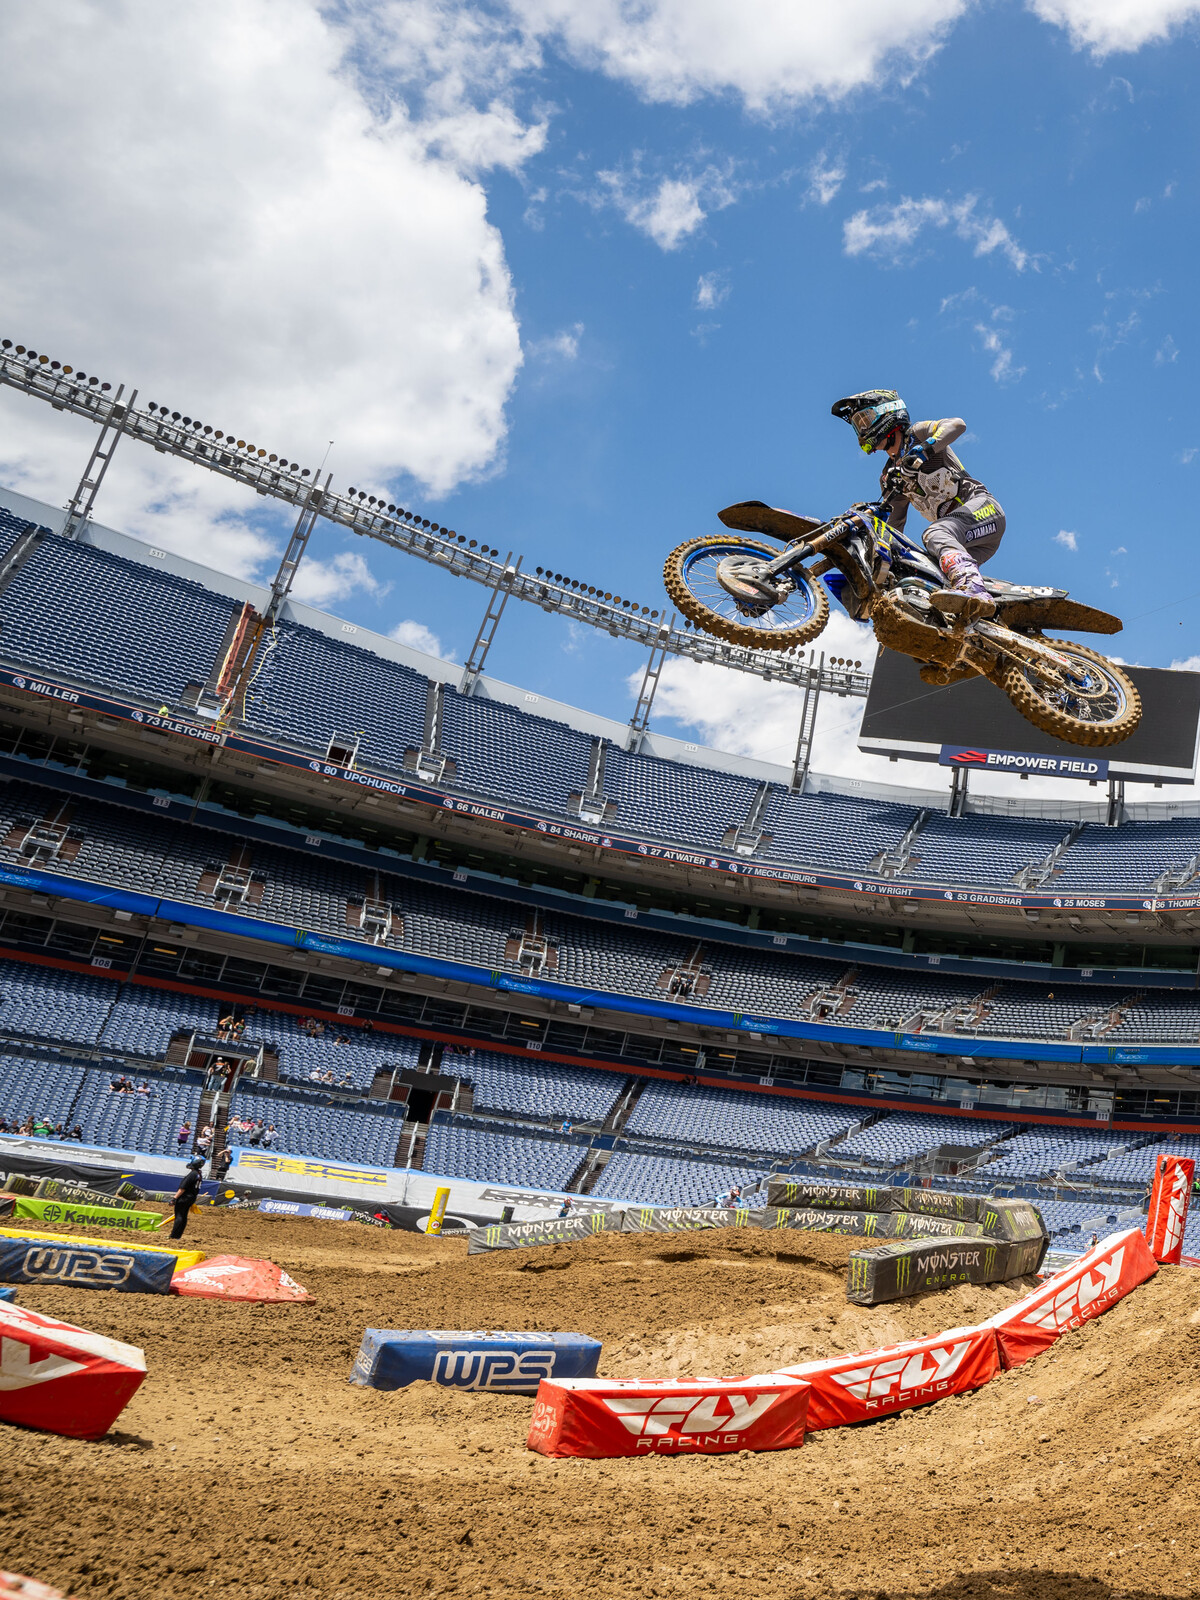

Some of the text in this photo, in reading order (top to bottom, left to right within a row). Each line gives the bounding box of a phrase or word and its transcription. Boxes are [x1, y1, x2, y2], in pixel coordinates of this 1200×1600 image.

[972, 522, 997, 540] YAMAHA
[29, 681, 80, 702] MILLER
[145, 714, 221, 744] 73 FLETCHER
[987, 753, 1098, 774] EMPOWER FIELD
[323, 765, 407, 796] 80 UPCHURCH
[456, 802, 505, 821] 66 NALEN
[307, 837, 320, 845] 314
[550, 825, 600, 845] 84 SHARPE
[651, 847, 706, 866] 27 ATWATER
[742, 866, 817, 884] 77 MECKLENBURG
[865, 884, 913, 897] 20 WRIGHT
[957, 892, 1022, 906] 53 GRADISHAR
[1064, 899, 1106, 908] 25 MOSES
[94, 957, 110, 967] 108
[339, 1006, 353, 1015] 109
[62, 1186, 118, 1207] MONSTER
[802, 1185, 860, 1199] MONSTER
[915, 1191, 953, 1207] MONSTER
[273, 1202, 299, 1212] YAMAHA
[318, 1207, 345, 1219] YAMAHA
[659, 1210, 728, 1222] MONSTER
[64, 1210, 140, 1229] Kawasaki
[355, 1210, 383, 1227] MONSTER
[508, 1217, 584, 1238] MONSTER
[794, 1212, 859, 1226] MONSTER
[909, 1216, 953, 1235] MONSTER
[520, 1232, 574, 1244] ENERGY
[22, 1247, 136, 1284] WPS
[917, 1250, 981, 1274] MONSTER
[172, 1277, 225, 1290] HONDA
[926, 1273, 971, 1285] ENERGY
[1020, 1245, 1126, 1330] FLY
[1058, 1286, 1119, 1335] RACING
[431, 1351, 557, 1391] WPS
[830, 1340, 973, 1400] FLY
[866, 1380, 948, 1410] RACING
[601, 1393, 781, 1436] FLY
[636, 1434, 740, 1448] RACING
